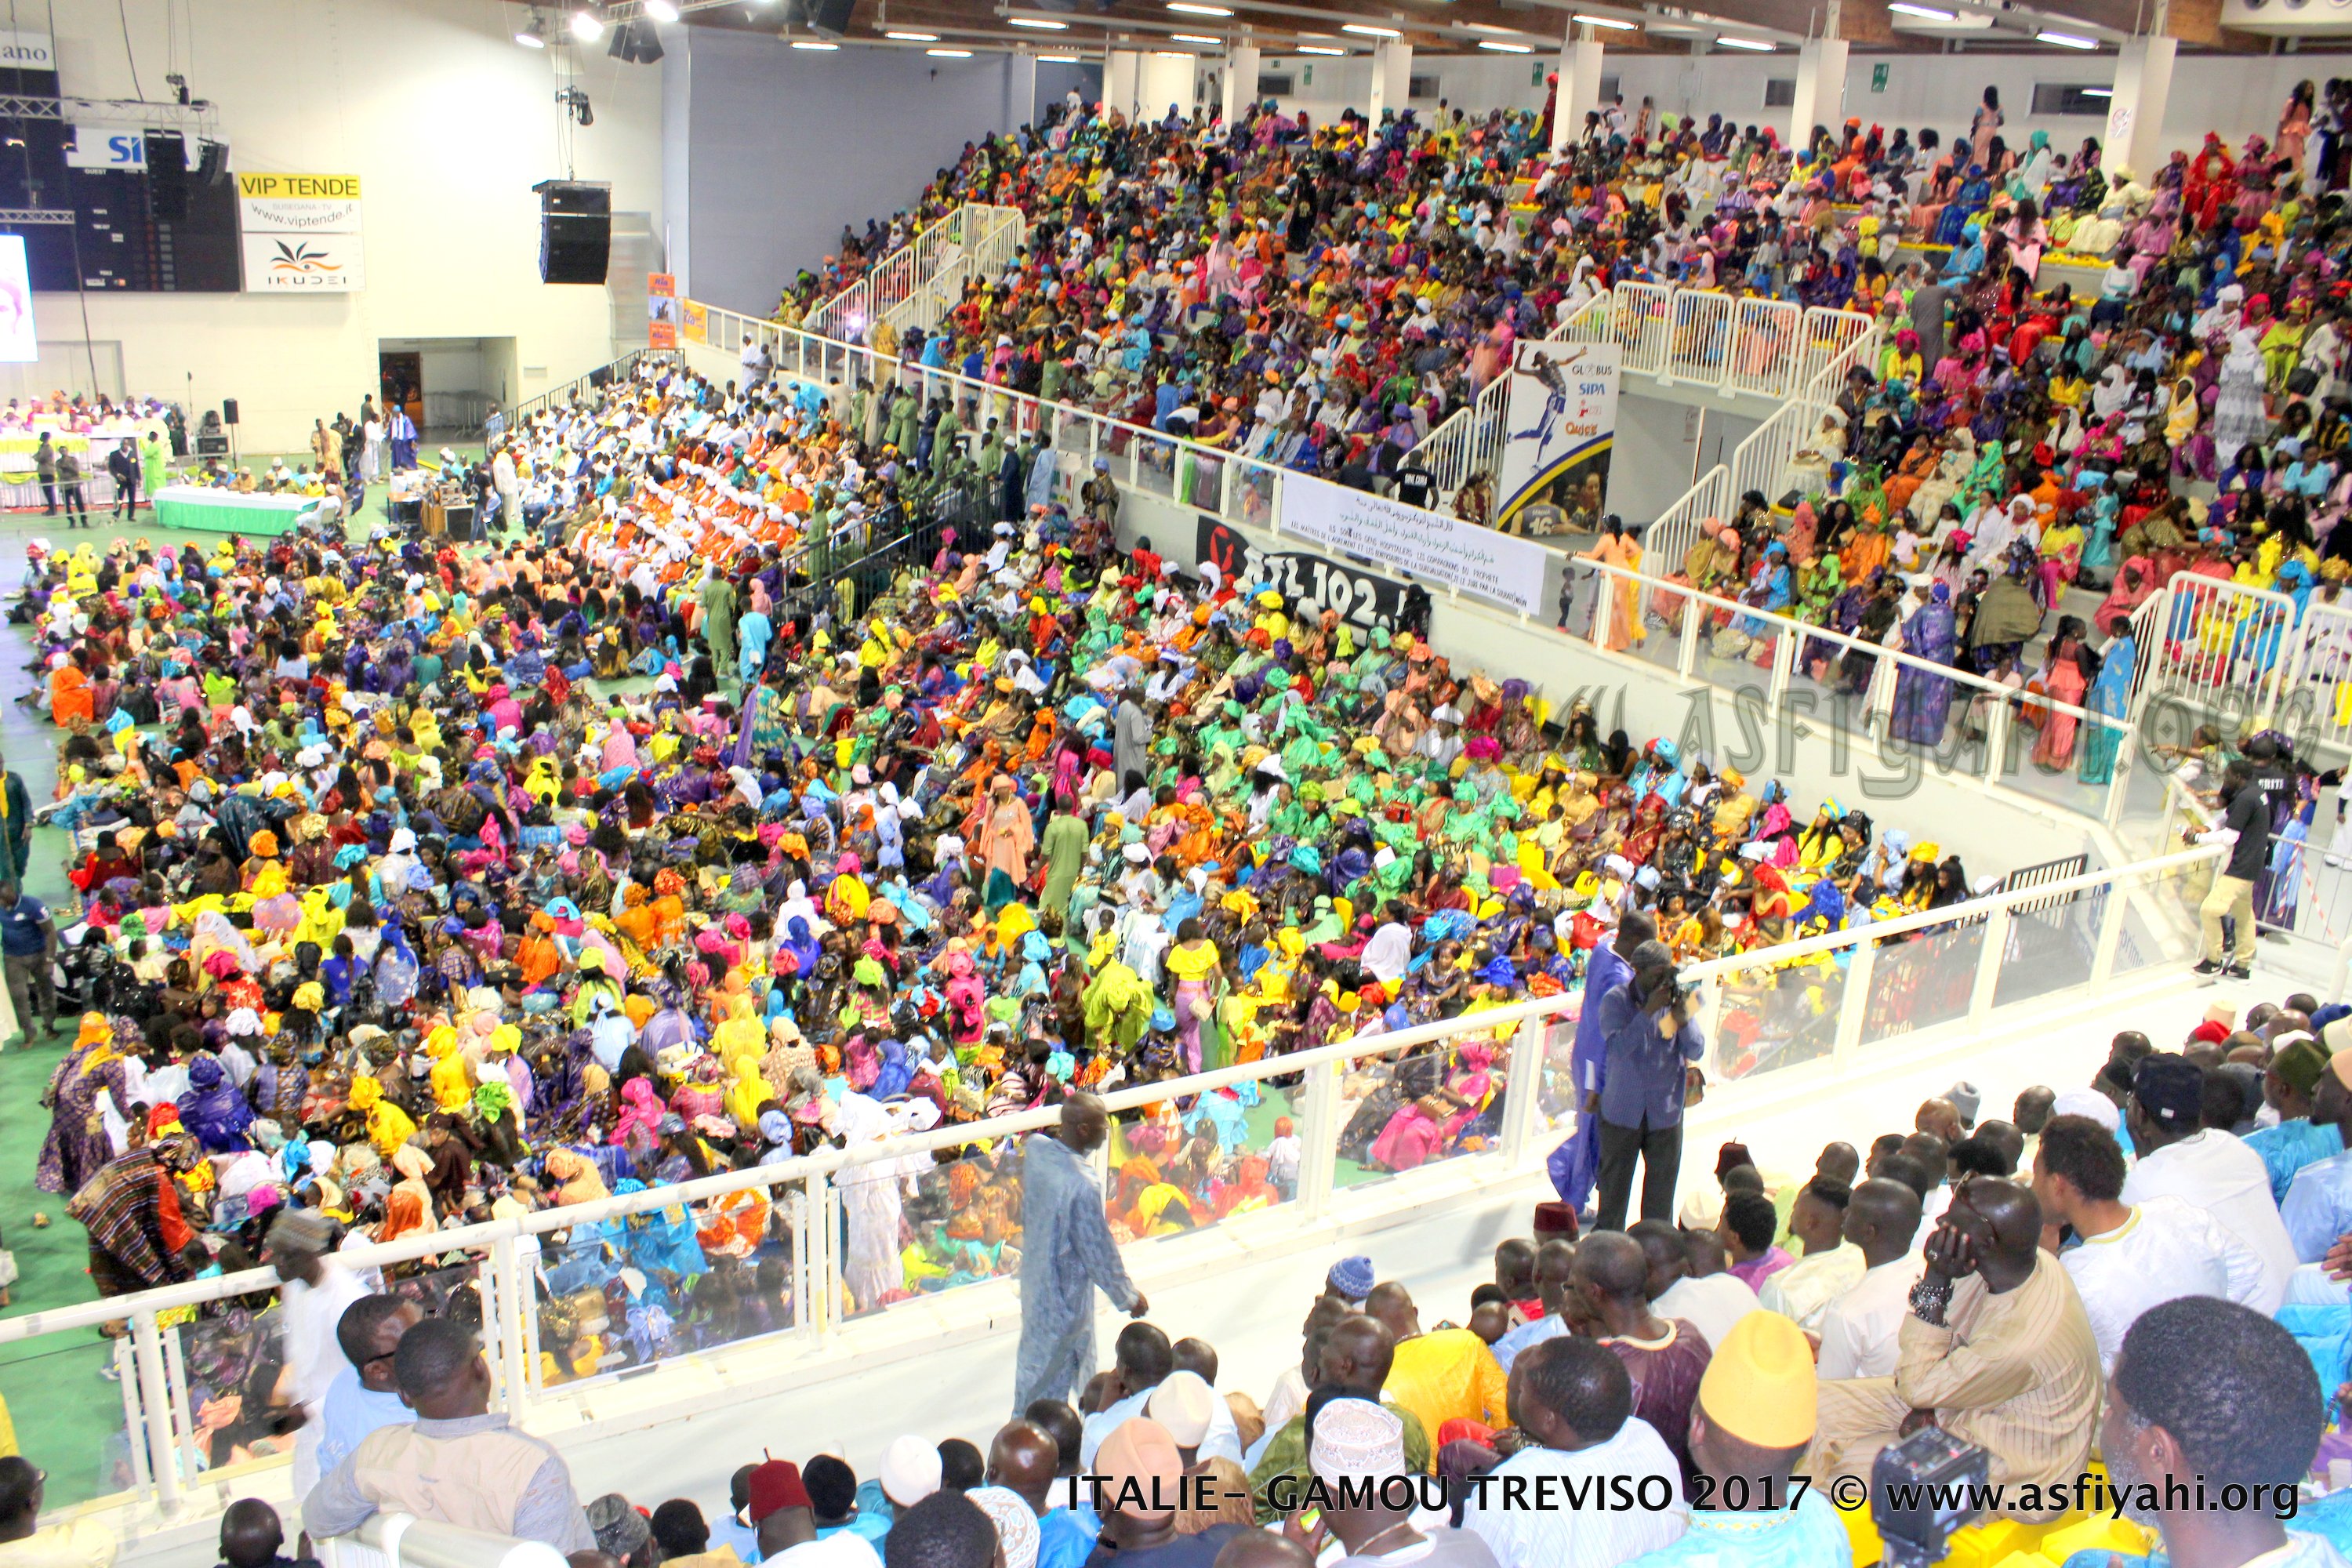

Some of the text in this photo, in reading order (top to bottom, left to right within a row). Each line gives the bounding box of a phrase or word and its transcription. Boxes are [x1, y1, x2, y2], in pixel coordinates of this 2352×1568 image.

[0, 45, 47, 61] ano
[241, 177, 358, 195] VIP TENDE
[251, 202, 353, 229] www.viptende.it
[1312, 561, 1409, 630] 102.
